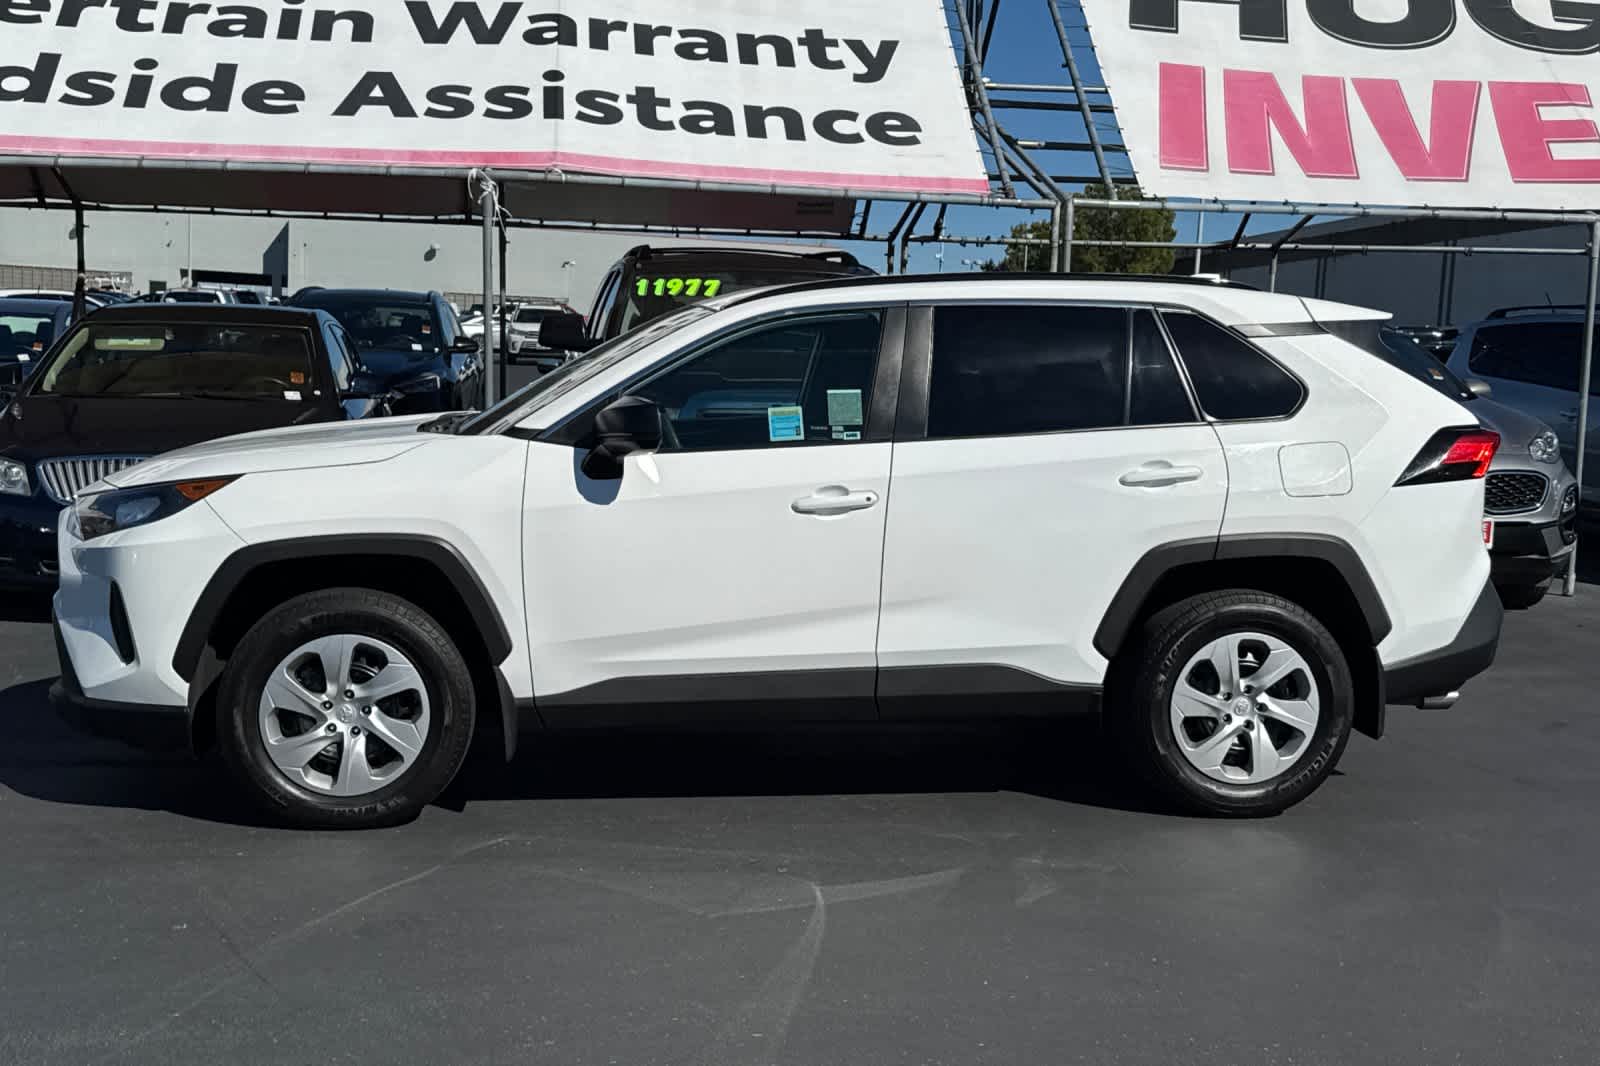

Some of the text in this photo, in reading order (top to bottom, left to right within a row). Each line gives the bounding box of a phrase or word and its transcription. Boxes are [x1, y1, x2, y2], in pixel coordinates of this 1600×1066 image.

[0, 0, 899, 84] ertrain Warranty
[0, 52, 923, 147] dside Assistance
[1158, 62, 1600, 184] INVE
[635, 277, 721, 298] 11977
